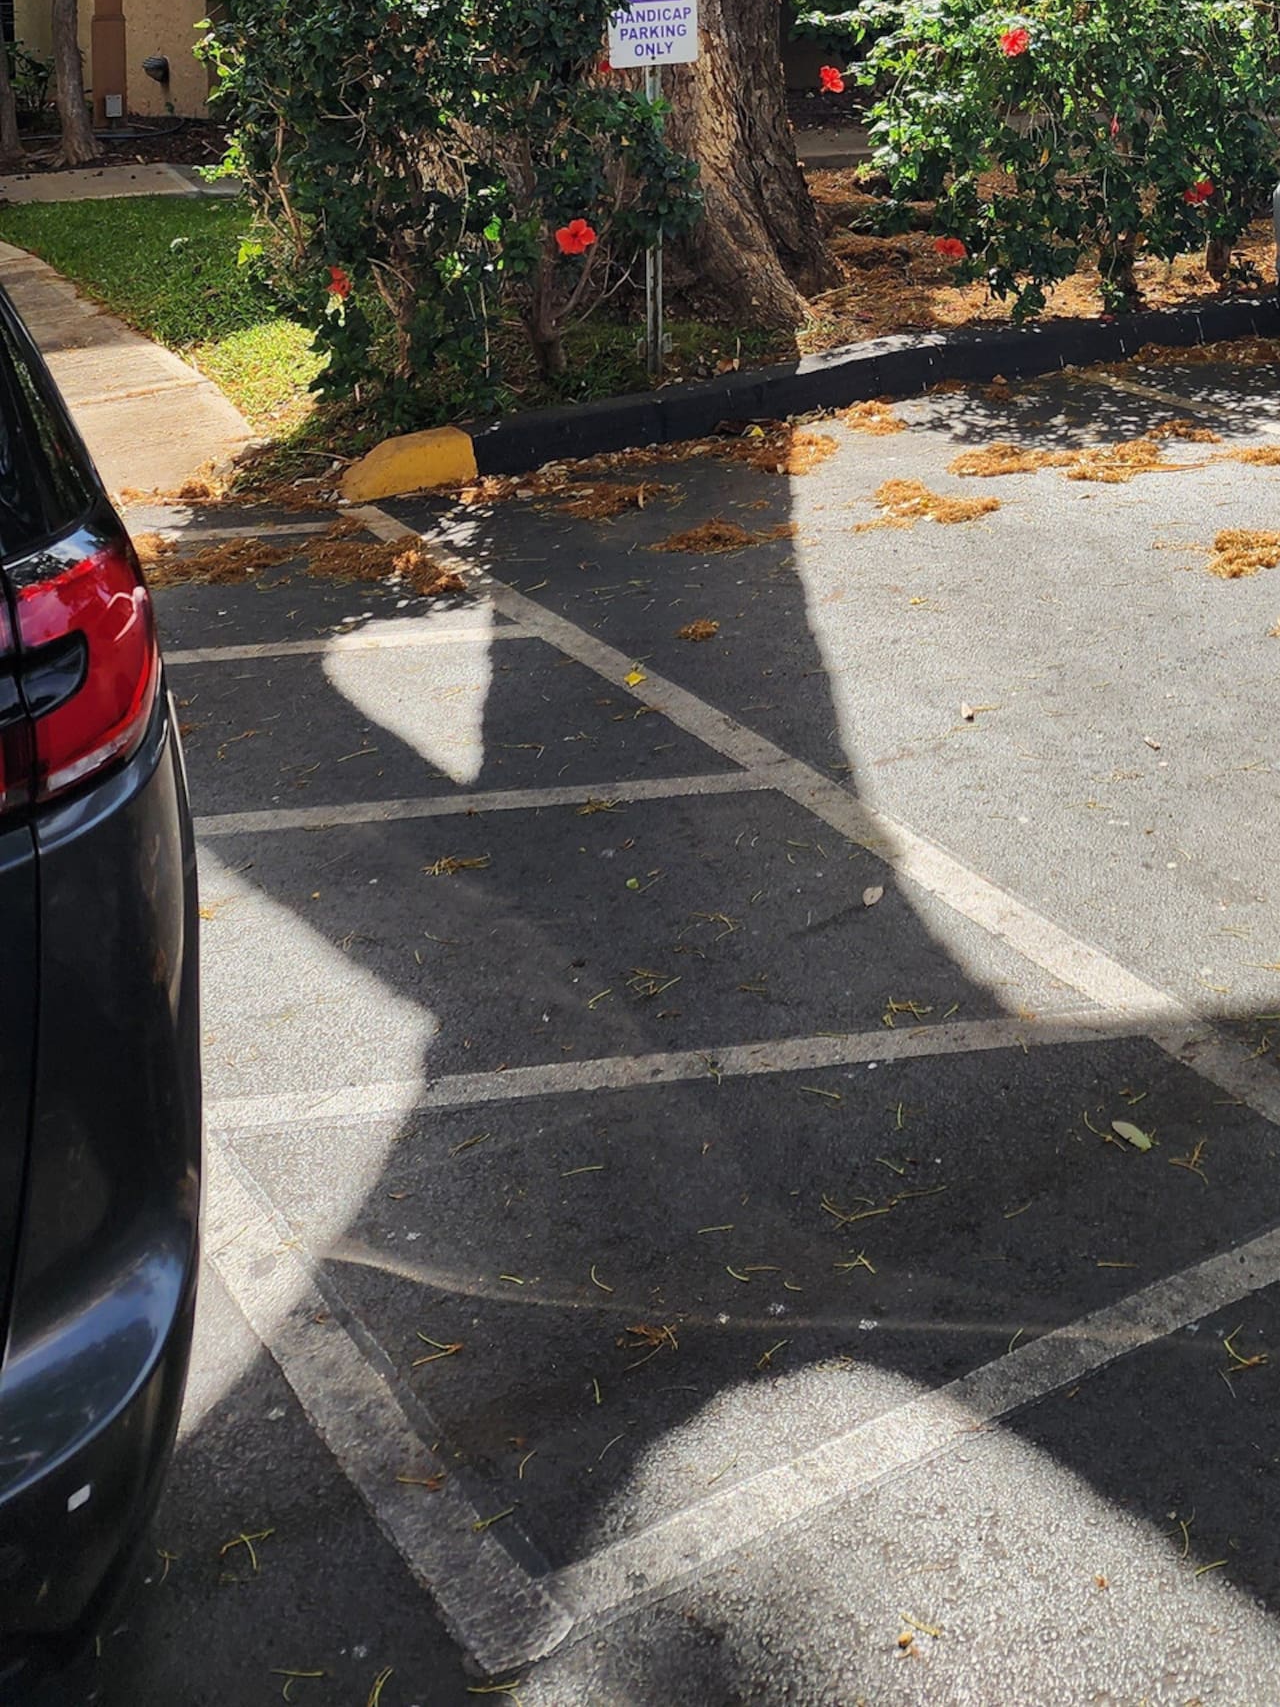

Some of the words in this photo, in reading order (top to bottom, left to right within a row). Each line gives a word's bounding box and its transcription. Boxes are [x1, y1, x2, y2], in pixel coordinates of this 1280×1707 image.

[614, 7, 692, 24] HANDICAP
[620, 24, 687, 41] PARKING
[634, 41, 674, 57] ONLY
